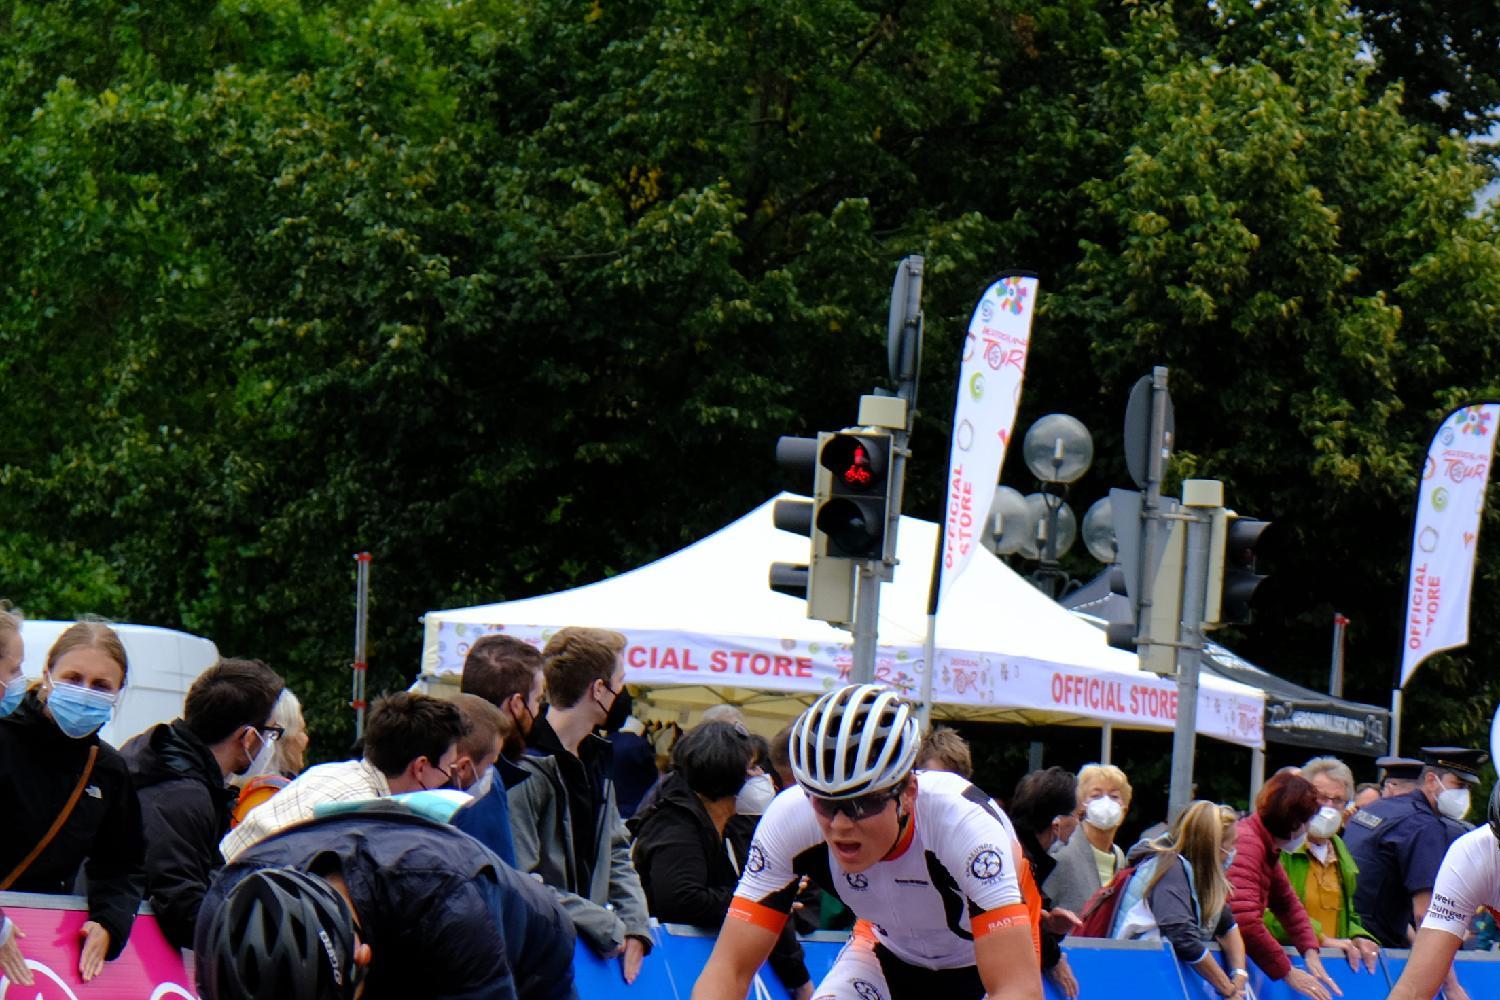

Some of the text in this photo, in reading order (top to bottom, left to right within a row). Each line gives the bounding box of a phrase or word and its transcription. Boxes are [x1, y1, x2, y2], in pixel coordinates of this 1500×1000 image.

[945, 463, 964, 569] OFFICIAL
[959, 481, 973, 557] STORE
[1409, 563, 1428, 650] OFFICIAL
[710, 651, 813, 678] STORE
[1051, 673, 1178, 720] OFFICIAL STORE
